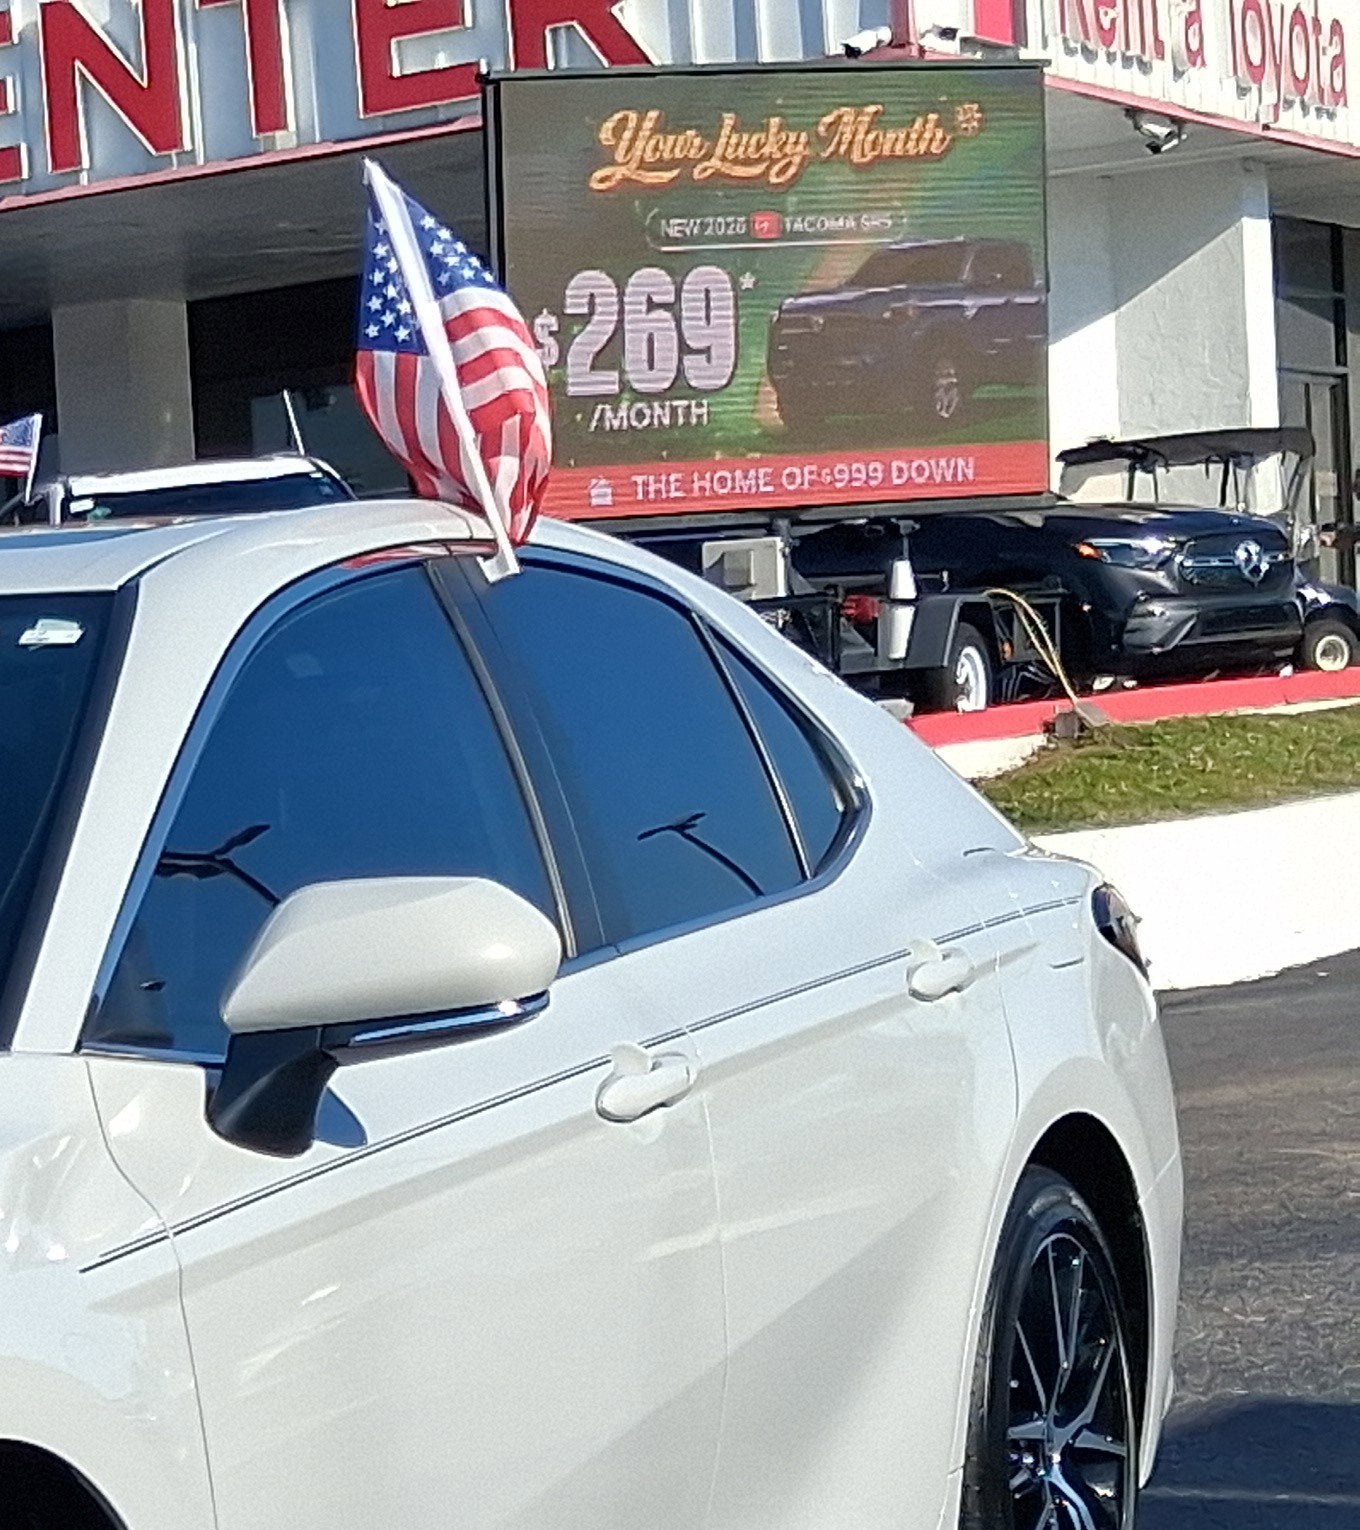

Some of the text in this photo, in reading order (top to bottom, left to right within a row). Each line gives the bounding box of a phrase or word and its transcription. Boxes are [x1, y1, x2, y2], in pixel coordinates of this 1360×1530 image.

[1183, 9, 1208, 69] a
[589, 104, 954, 191] Your Lucky Month
[660, 217, 701, 238] NEW
[588, 399, 709, 433] /MONTH
[631, 473, 685, 501] THE
[692, 467, 775, 496] HOME
[781, 463, 819, 491] OF
[891, 456, 976, 487] DOWN
